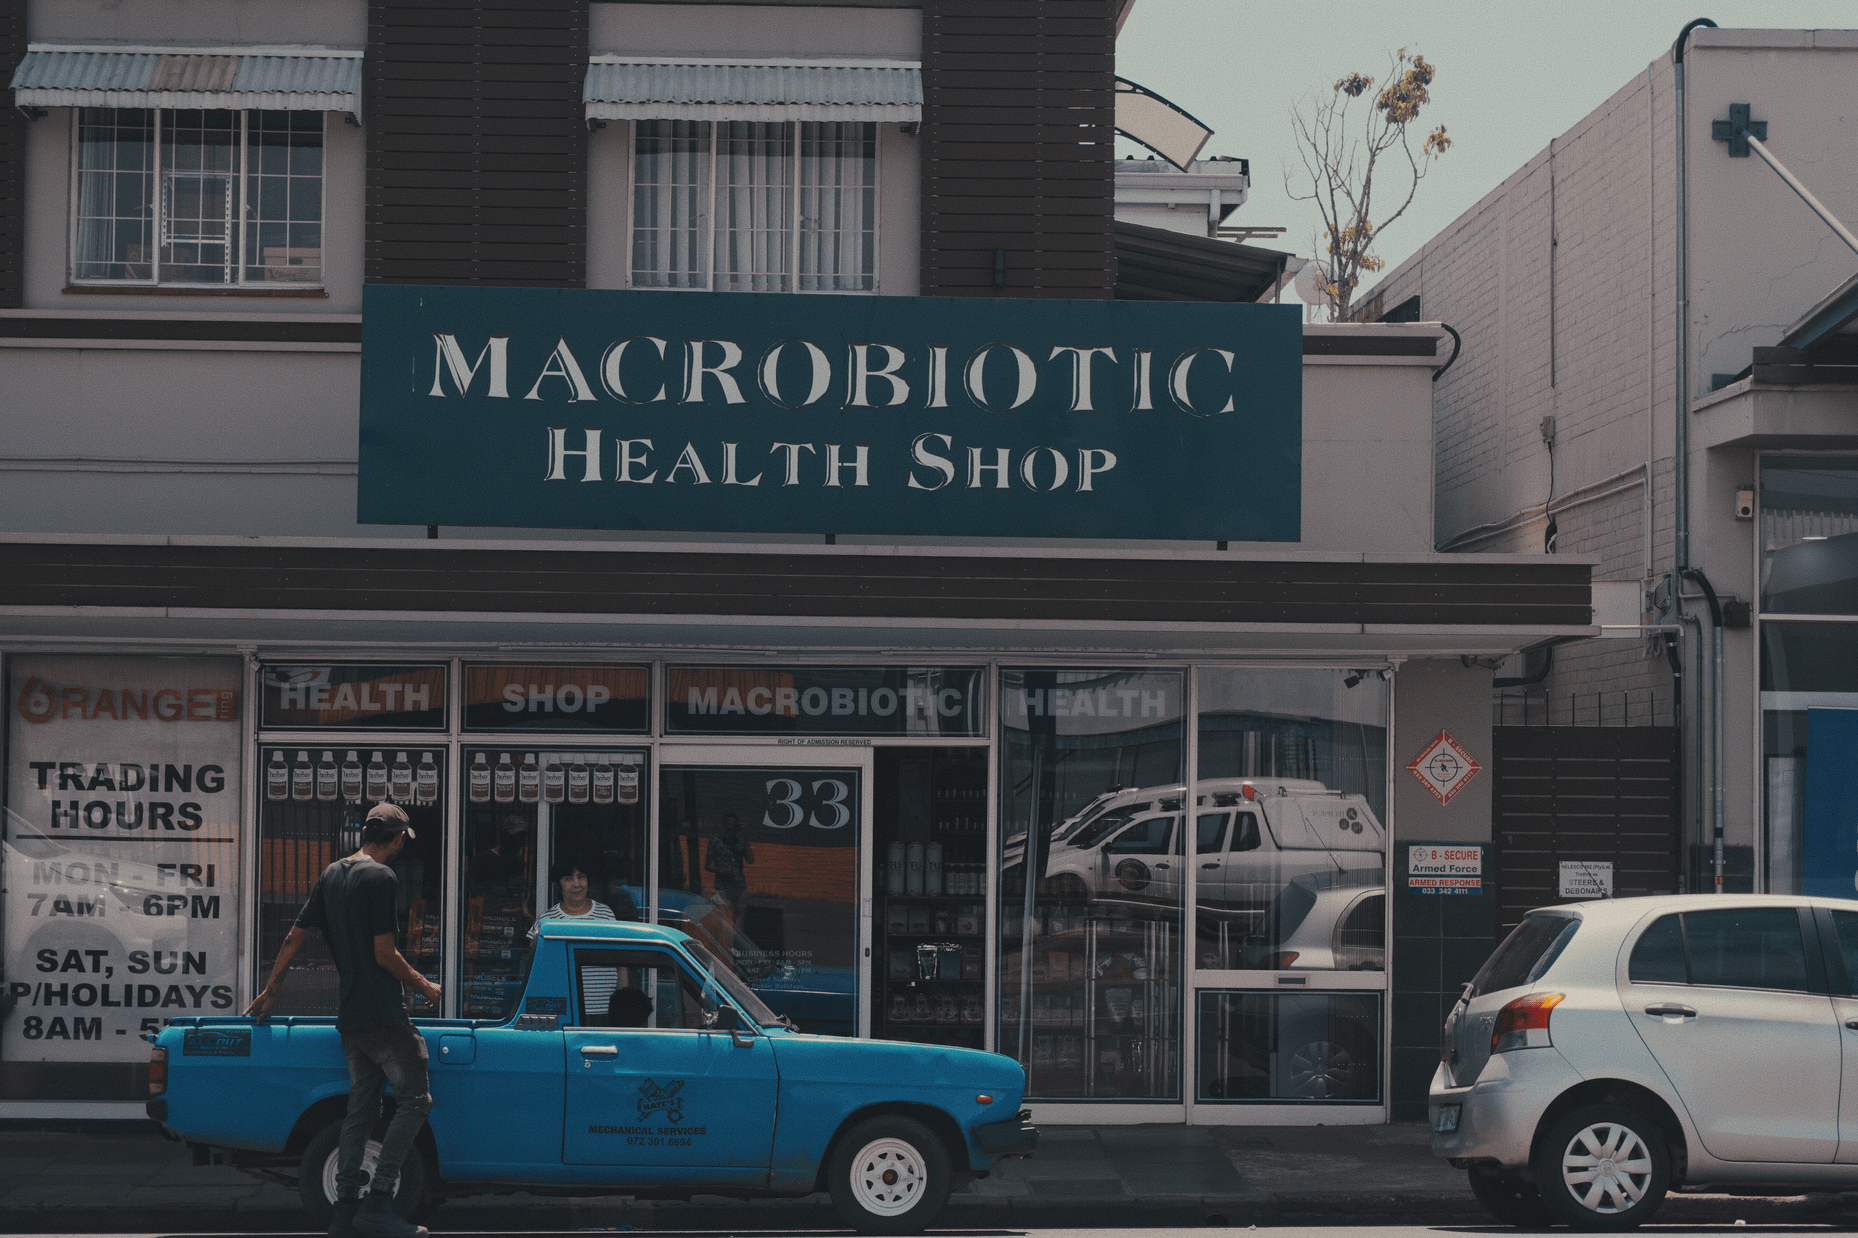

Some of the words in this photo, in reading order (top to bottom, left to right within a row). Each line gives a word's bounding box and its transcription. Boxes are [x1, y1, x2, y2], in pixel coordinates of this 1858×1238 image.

[428, 333, 1235, 418] MACROBIOTIC
[544, 427, 870, 488] HEALTH
[908, 432, 1117, 492] SHOP
[281, 681, 430, 712] HEALTH
[502, 683, 611, 713] SHOP
[687, 685, 962, 718] MACROBIOTIC
[1023, 688, 1166, 718] HEALTH
[1455, 746, 1473, 764] SECURE
[29, 761, 225, 793] TRADING
[51, 800, 203, 831] HOURS
[762, 778, 851, 830] 33
[1413, 864, 1446, 872] Armed
[1432, 850, 1437, 860] B
[1444, 850, 1478, 860] SECURE
[32, 861, 119, 886] MON
[157, 863, 215, 887] FRI
[27, 892, 106, 917] 7AM
[143, 894, 220, 918] 6PM
[36, 948, 113, 979] SAT,
[127, 950, 207, 975] SUN
[10, 981, 233, 1009] P/HOLIDAYS
[22, 1016, 102, 1041] 8AM
[588, 1125, 654, 1135] MECHANICAL
[657, 1127, 706, 1135] SERVICES
[627, 1137, 645, 1145] 072
[648, 1137, 664, 1146] 301
[668, 1138, 692, 1146] 6694
